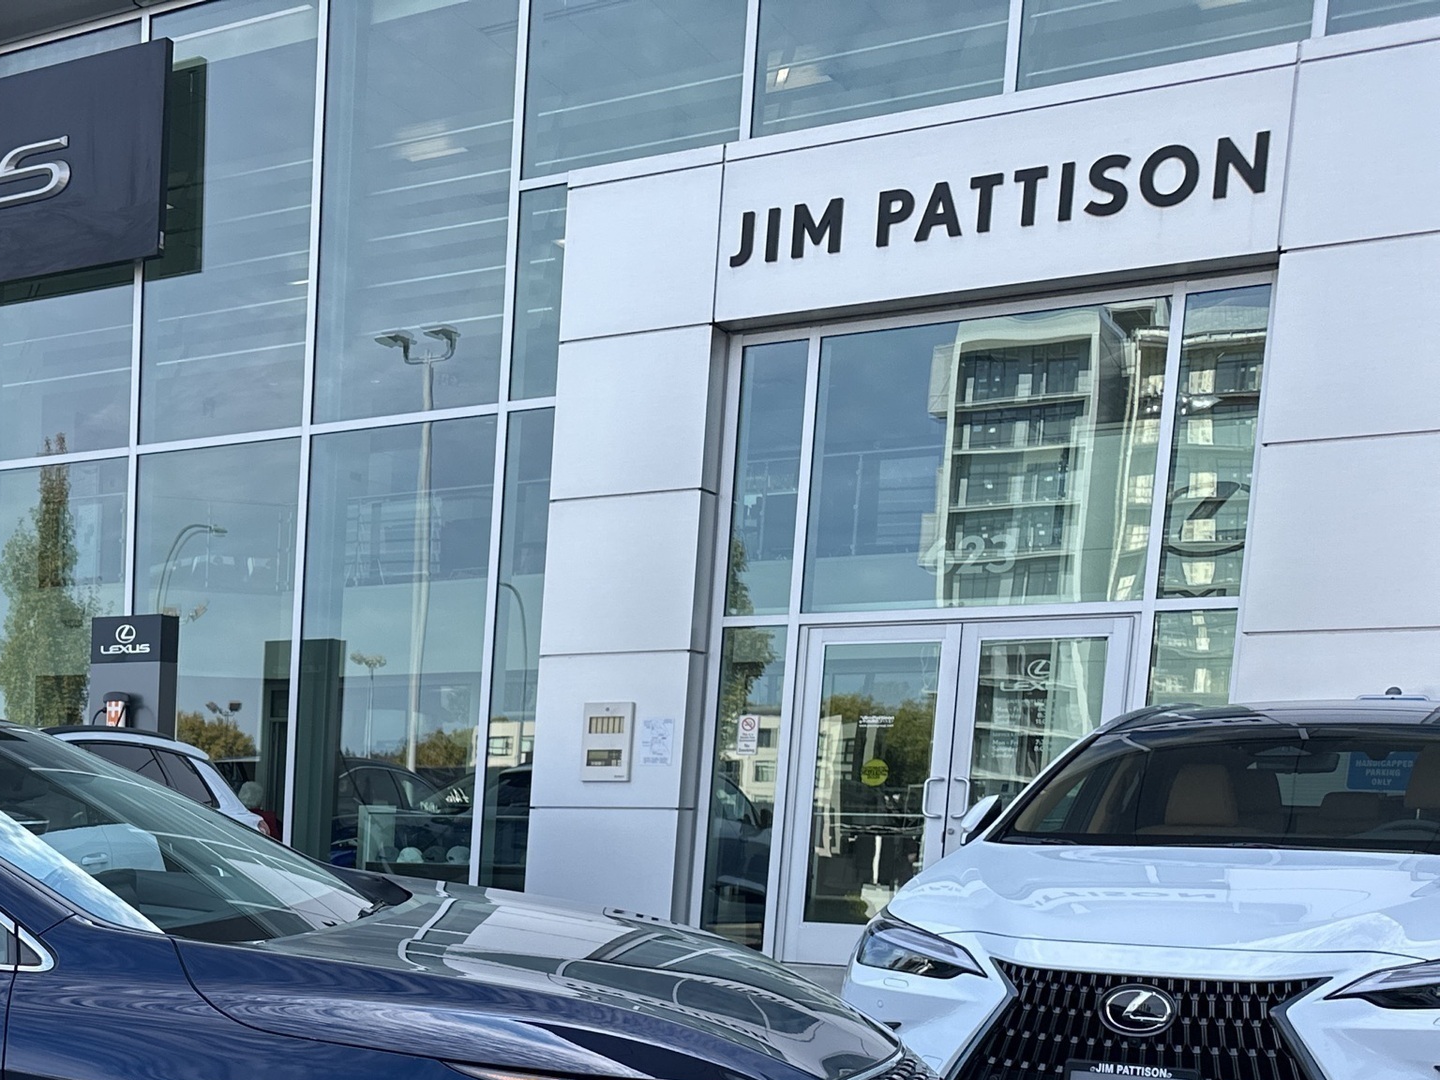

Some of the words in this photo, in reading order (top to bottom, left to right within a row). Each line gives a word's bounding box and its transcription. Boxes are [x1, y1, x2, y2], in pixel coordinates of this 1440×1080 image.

[729, 196, 845, 268] JIM
[875, 130, 1272, 248] PATTISON
[924, 535, 1017, 576] 623
[100, 643, 151, 655] LEXUS
[1371, 777, 1392, 786] ONLY
[1095, 1063, 1114, 1074] JIM
[1116, 1064, 1168, 1078] PATTISON
